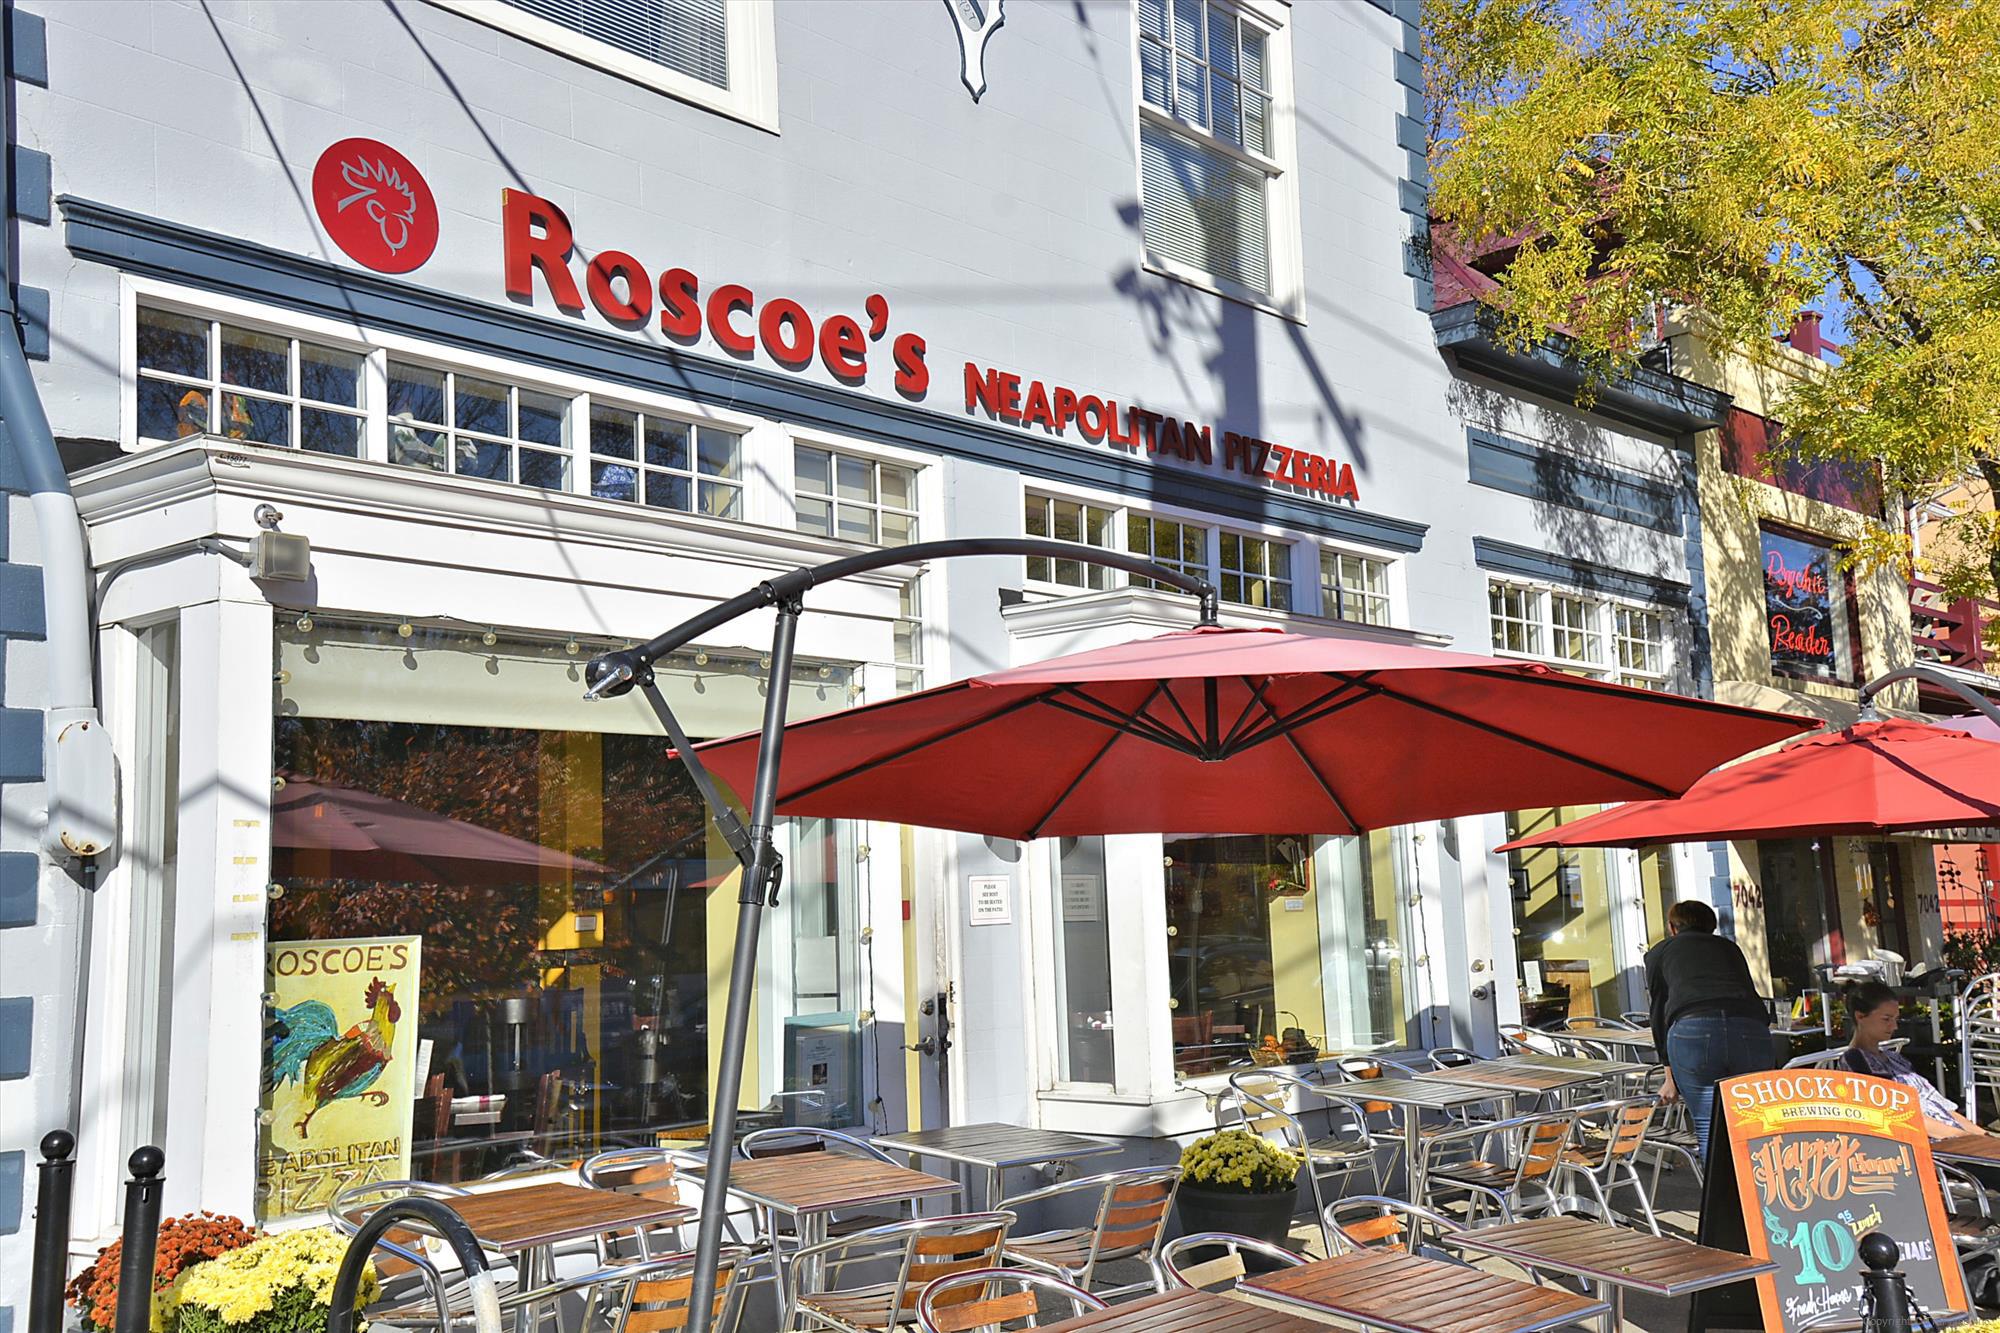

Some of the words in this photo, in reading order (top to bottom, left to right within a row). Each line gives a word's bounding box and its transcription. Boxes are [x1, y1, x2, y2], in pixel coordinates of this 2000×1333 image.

[502, 187, 929, 395] Roscoe's
[964, 362, 1213, 466] NEAPOLITAN
[1224, 431, 1360, 502] PIZZERIA
[1767, 550, 1826, 598] Psychic
[1771, 614, 1830, 656] Reader
[1733, 884, 1763, 909] 7042
[1917, 895, 1940, 914] 7042
[1730, 1076, 1838, 1110] SHOCK
[1845, 1077, 1911, 1111] TOP
[1782, 1105, 1841, 1119] BREWING
[1845, 1108, 1865, 1120] CO.
[259, 1137, 401, 1178] EAPOLITAN
[1751, 1134, 1861, 1211] Happy
